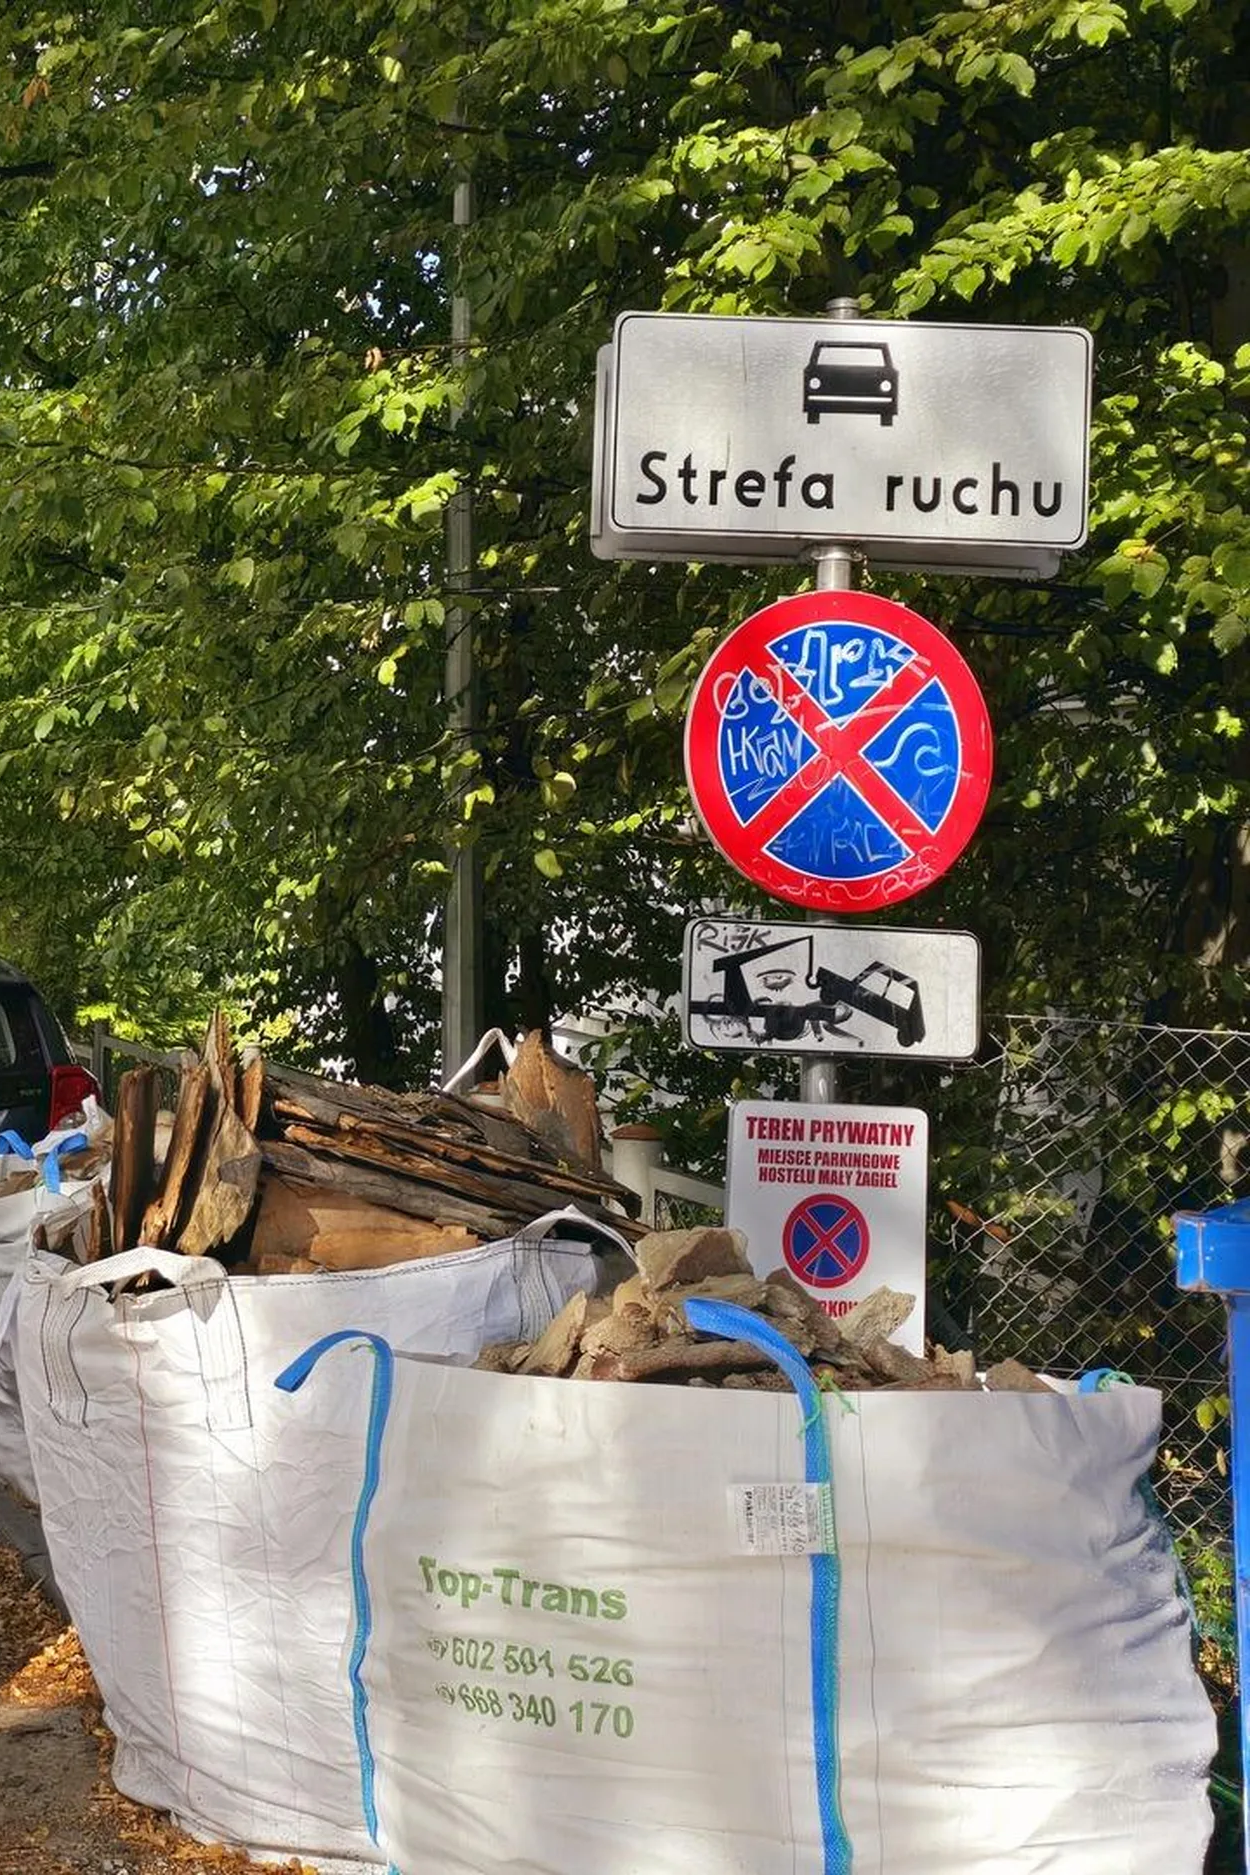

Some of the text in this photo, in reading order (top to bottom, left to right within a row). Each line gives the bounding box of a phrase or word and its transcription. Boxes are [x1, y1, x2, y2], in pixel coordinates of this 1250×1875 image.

[636, 450, 1063, 518] Strefa ruchu
[746, 1116, 915, 1147] TEREN PRYWATNY
[757, 1148, 900, 1170] MIEJSCE PARKINGOWE
[758, 1167, 899, 1188] HOSTELU MAŁY ŻAGIEL
[418, 1555, 629, 1622] Top-Trans
[451, 1636, 635, 1687] 602 501 526
[457, 1683, 635, 1739] 668 340 170
